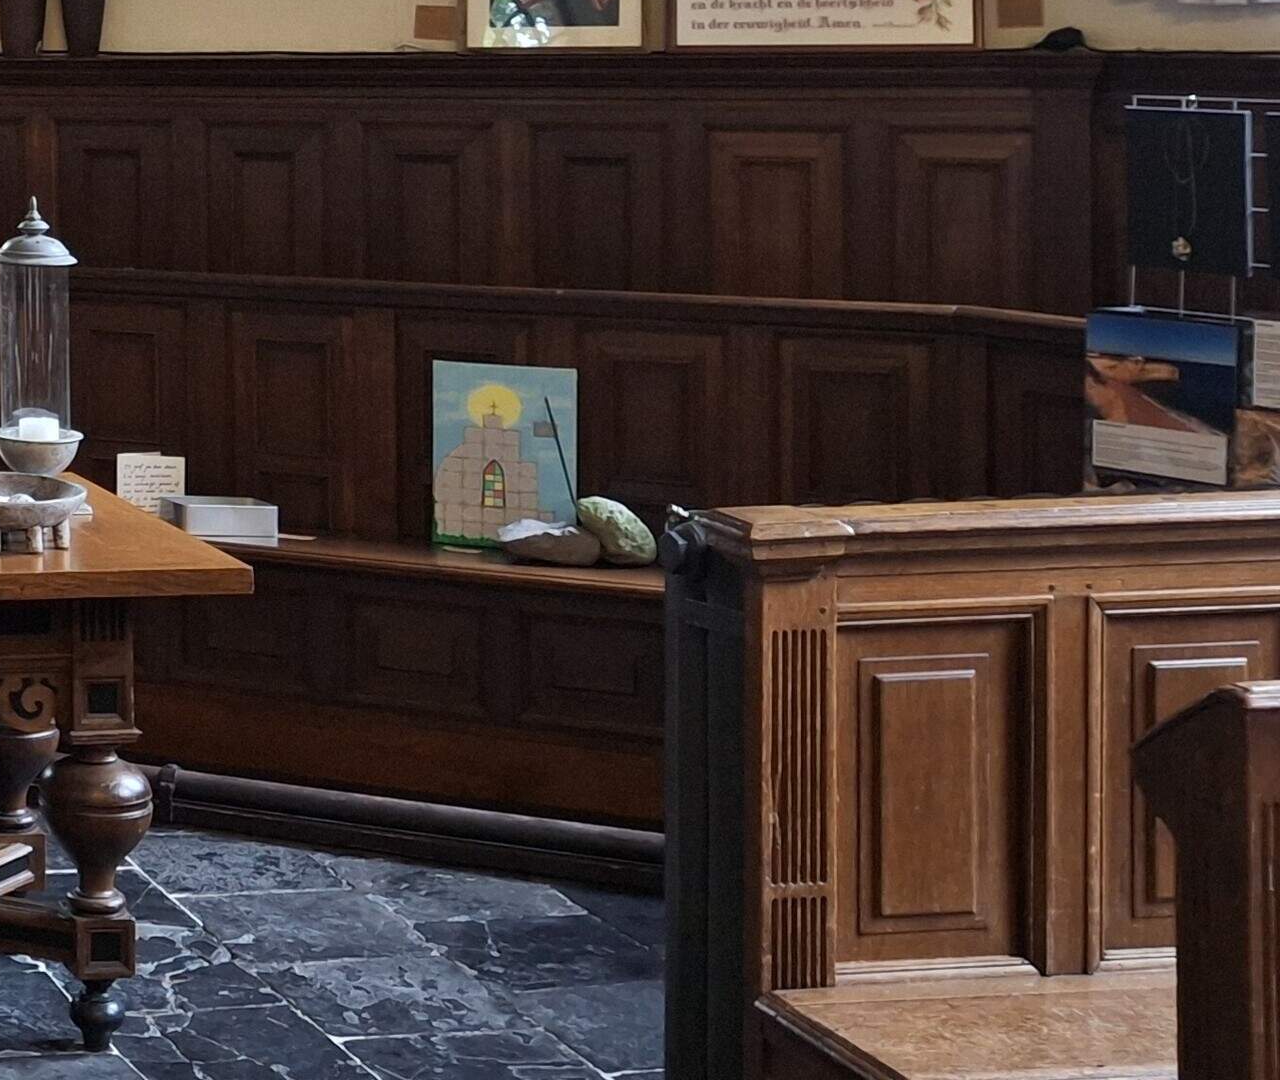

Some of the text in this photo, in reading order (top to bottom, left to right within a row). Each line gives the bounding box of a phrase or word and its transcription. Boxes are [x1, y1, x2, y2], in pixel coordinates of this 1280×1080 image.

[691, 0, 707, 10] en
[777, 0, 793, 9] en
[691, 19, 706, 30] in
[708, 19, 729, 30] der
